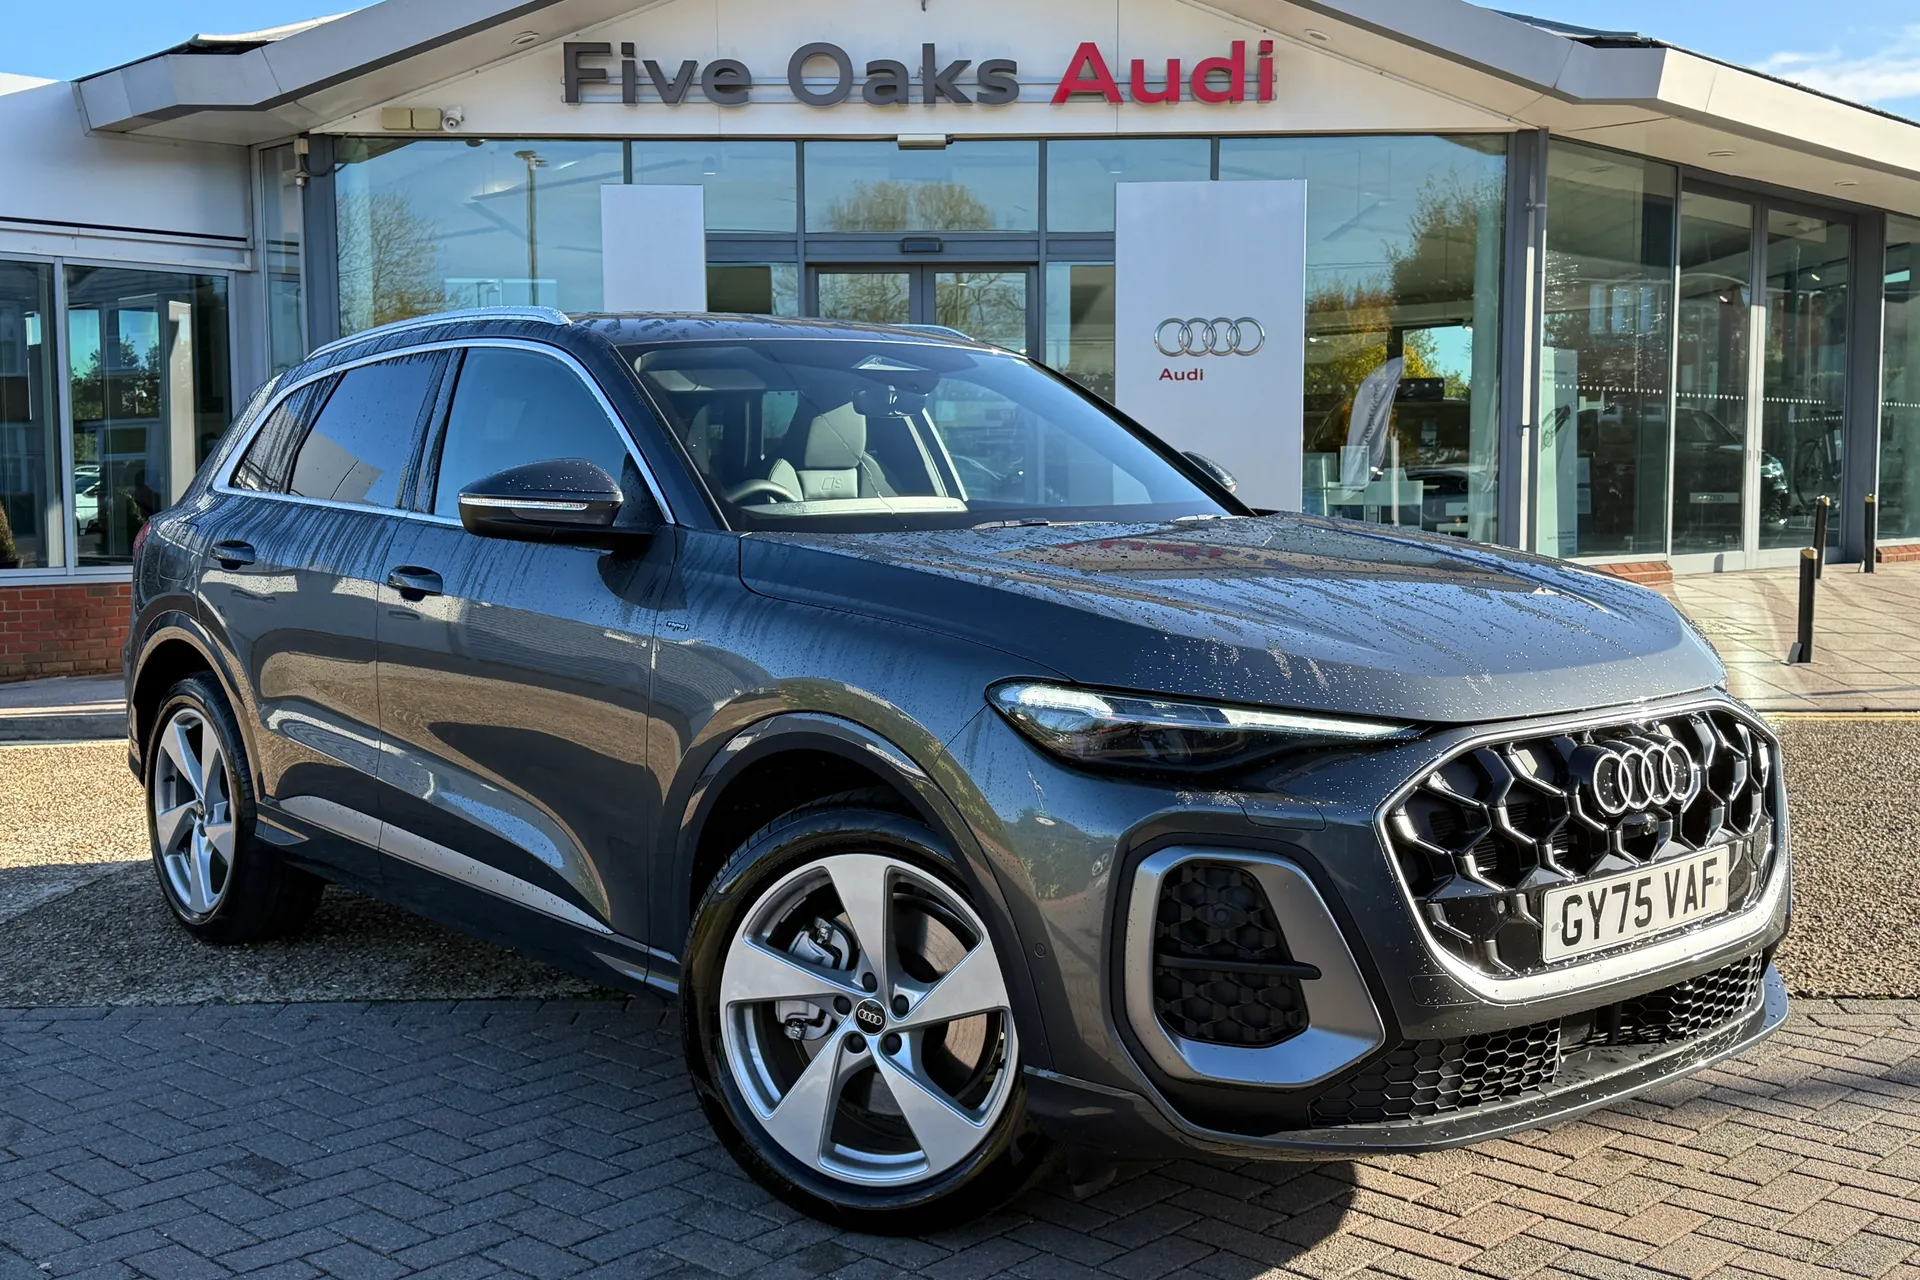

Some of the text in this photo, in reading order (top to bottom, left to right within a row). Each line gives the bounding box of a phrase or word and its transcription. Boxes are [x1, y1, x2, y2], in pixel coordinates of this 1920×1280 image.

[563, 40, 1274, 107] Five Oaks Audi
[1158, 367, 1204, 381] Audi
[1561, 856, 1718, 947] GY75 VAF
